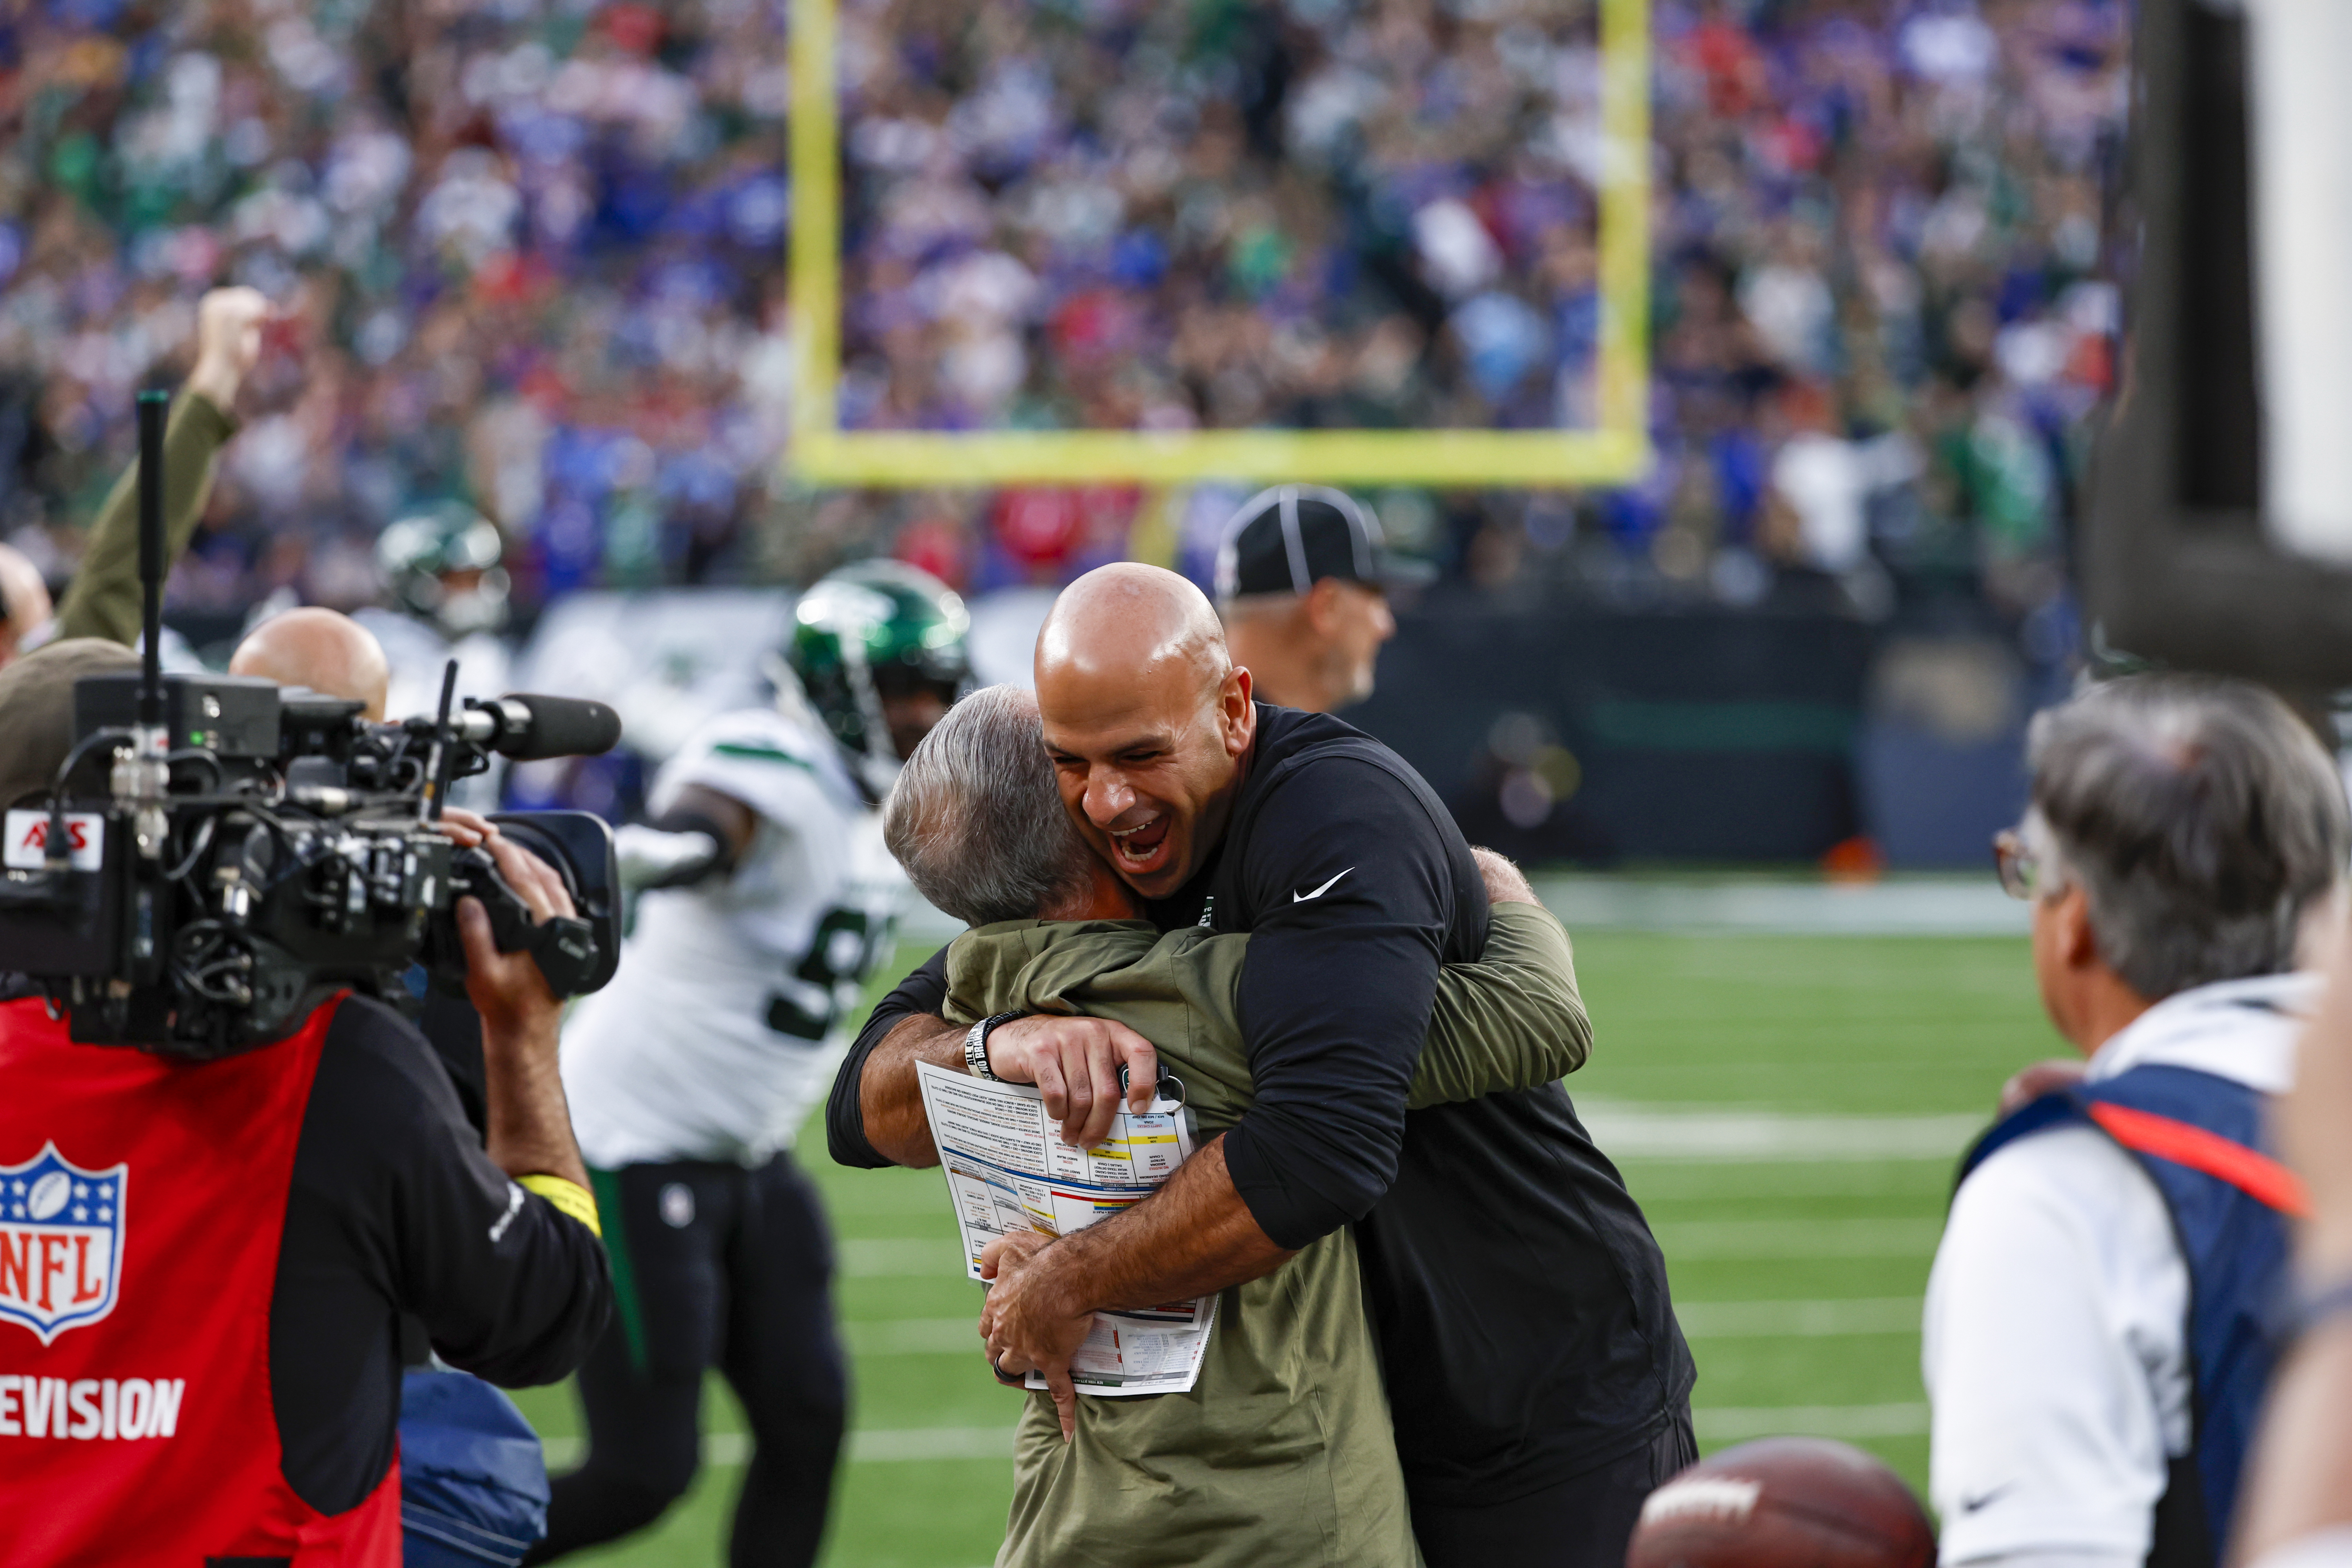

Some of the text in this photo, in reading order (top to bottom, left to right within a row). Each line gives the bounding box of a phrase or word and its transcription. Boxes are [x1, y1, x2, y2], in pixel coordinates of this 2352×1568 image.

[966, 1050, 975, 1065] ALL
[977, 1060, 989, 1071] NO
[0, 1230, 101, 1312] NFL
[0, 1375, 185, 1440] EVISION
